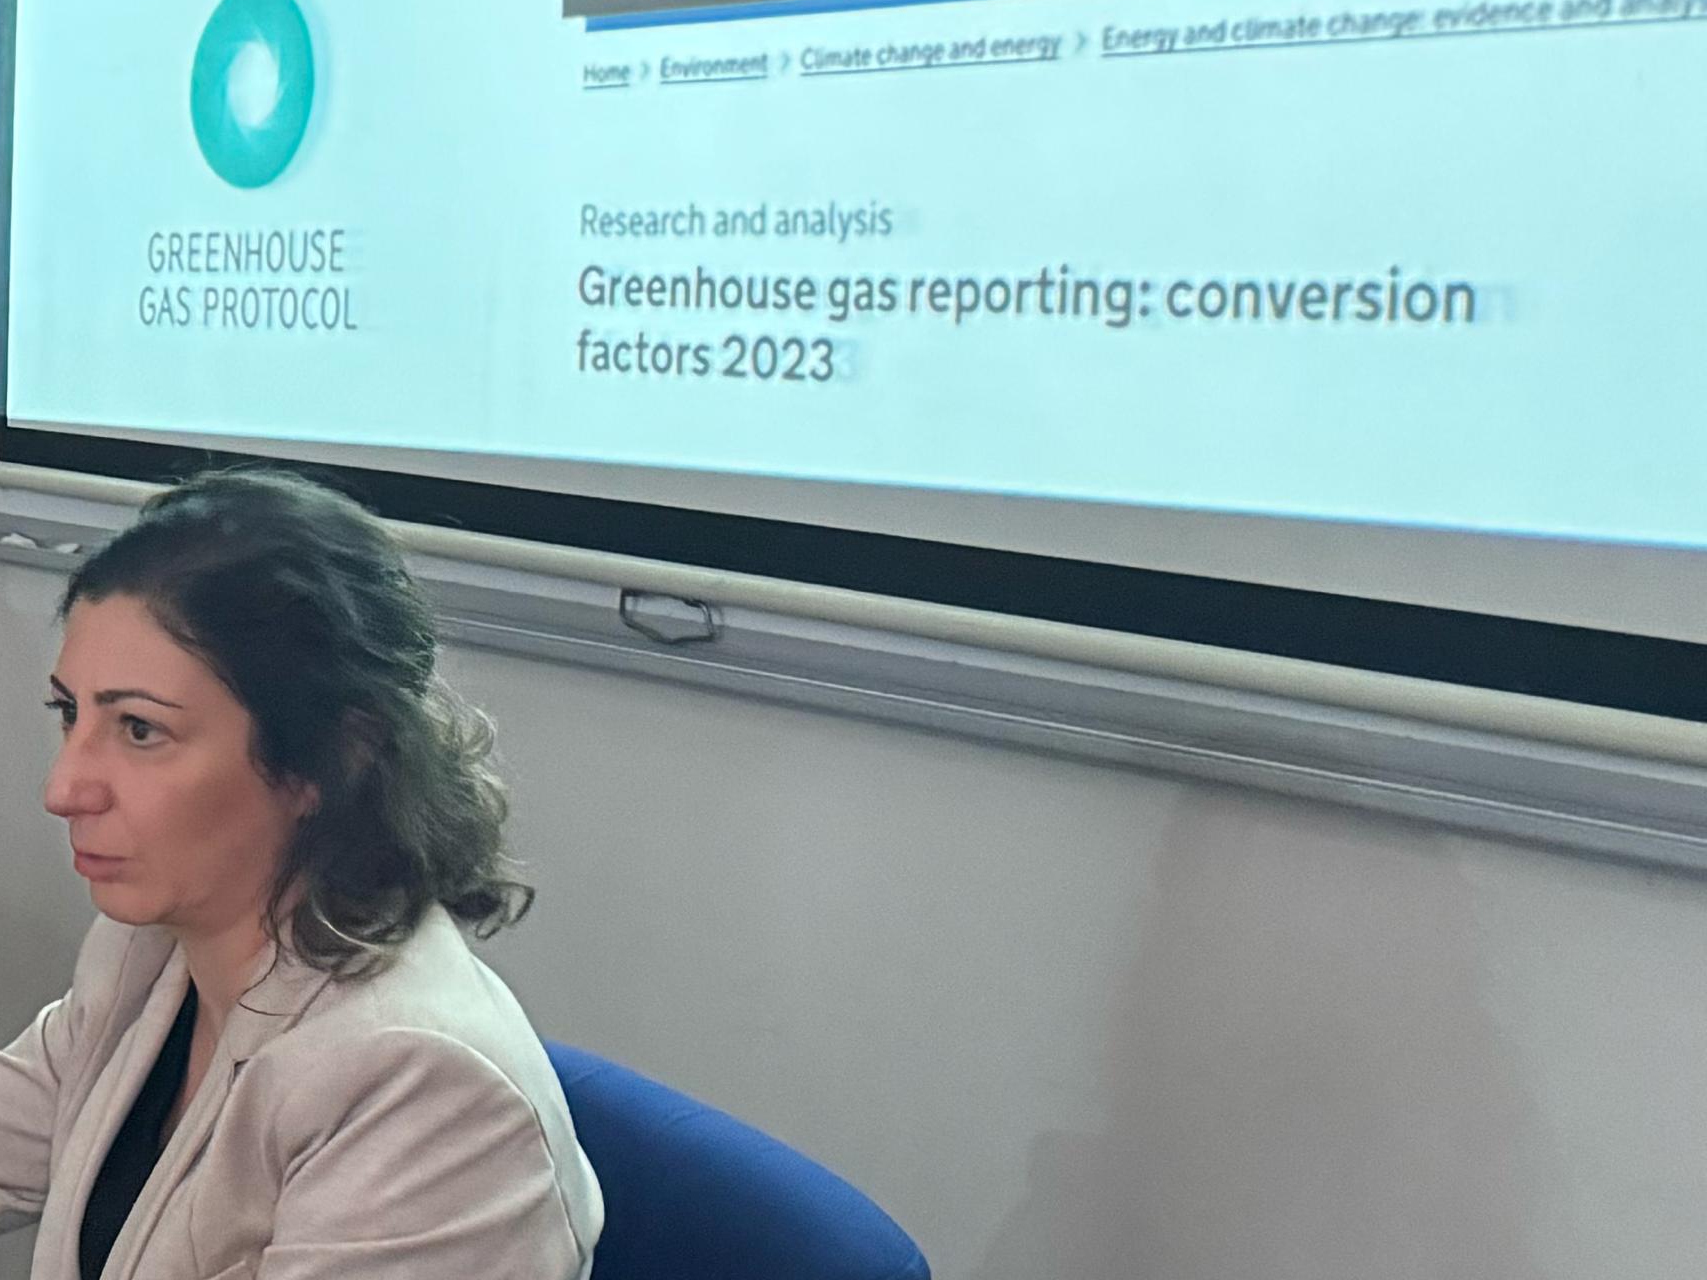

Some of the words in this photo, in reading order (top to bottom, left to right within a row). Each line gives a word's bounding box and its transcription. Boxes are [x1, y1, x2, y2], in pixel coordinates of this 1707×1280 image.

[584, 64, 630, 84] Home
[660, 53, 767, 79] Environment
[800, 46, 872, 70] Climate
[876, 42, 944, 67] change
[949, 36, 986, 59] and
[990, 33, 1061, 58] energy
[1102, 25, 1178, 52] Energy
[1183, 19, 1226, 44] and
[1231, 16, 1321, 42] climate
[1434, 0, 1552, 29] evidence
[580, 204, 704, 238] Research
[713, 206, 765, 237] and
[774, 201, 893, 243] analysis
[148, 229, 345, 273] GREENHOUSE
[139, 286, 189, 327] GAS
[204, 286, 358, 331] PROTOCOL
[579, 265, 816, 310] Greenhouse
[828, 275, 896, 321] gas
[910, 264, 1151, 327] reporting:
[1166, 264, 1475, 322] conversion
[577, 329, 710, 376] factors
[722, 334, 834, 382] 2023
